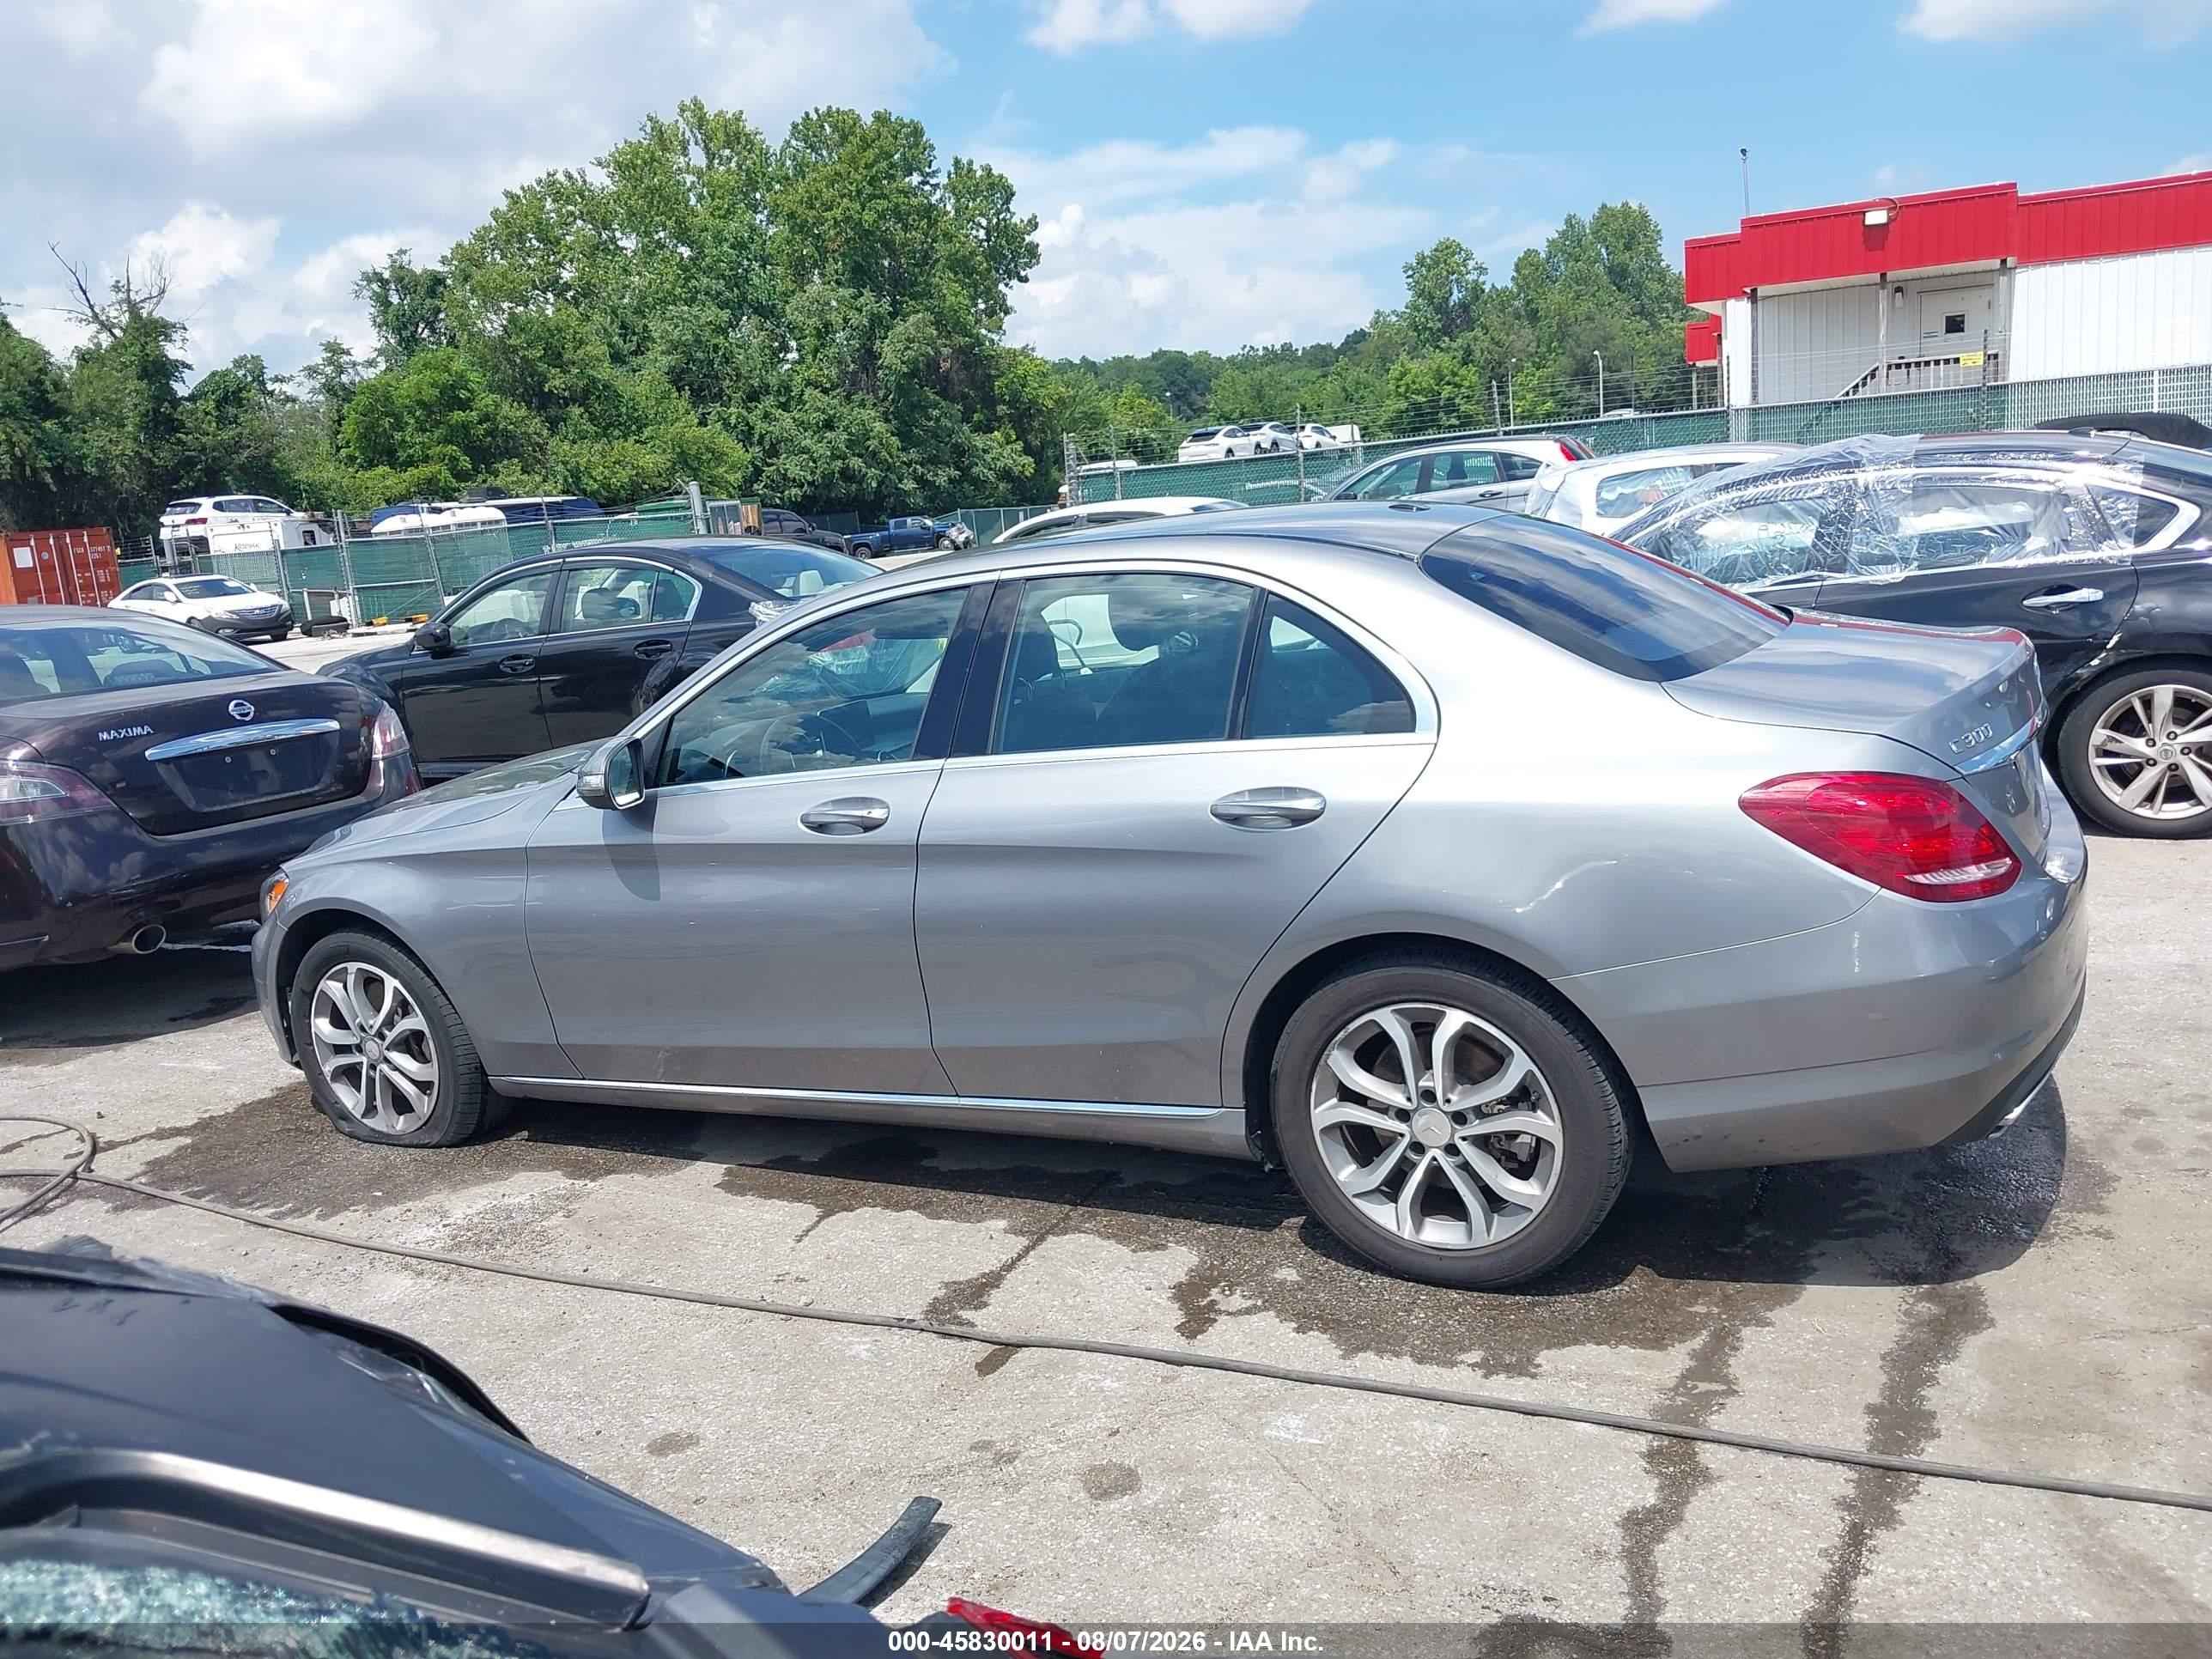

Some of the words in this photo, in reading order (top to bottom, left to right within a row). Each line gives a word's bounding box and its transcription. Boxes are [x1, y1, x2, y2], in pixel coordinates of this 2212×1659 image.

[98, 725, 154, 741] MAXIMA
[1948, 738, 1964, 754] C
[1961, 723, 1993, 748] 300
